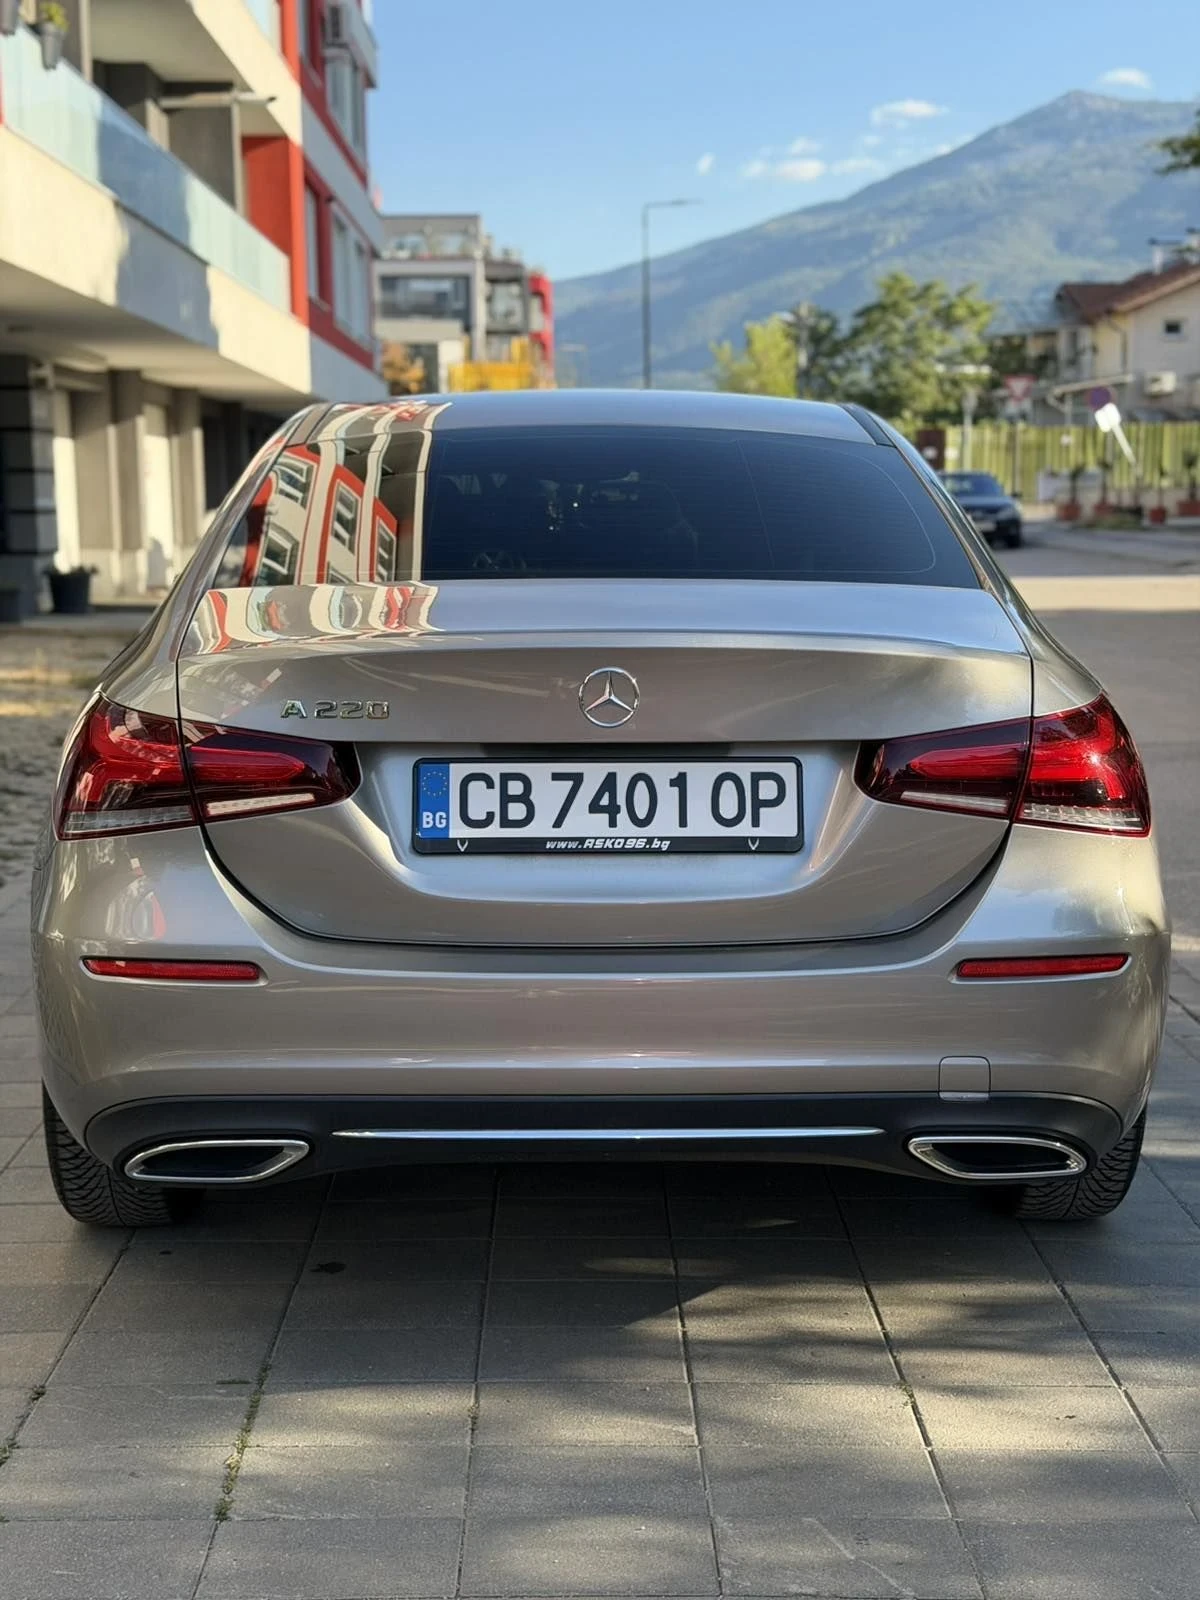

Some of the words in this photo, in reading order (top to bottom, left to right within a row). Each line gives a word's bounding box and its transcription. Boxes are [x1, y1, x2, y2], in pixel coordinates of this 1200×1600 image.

[281, 699, 307, 718] A
[314, 699, 390, 719] 220
[459, 772, 535, 829] CB
[551, 771, 688, 829] 7401
[422, 811, 447, 829] BG
